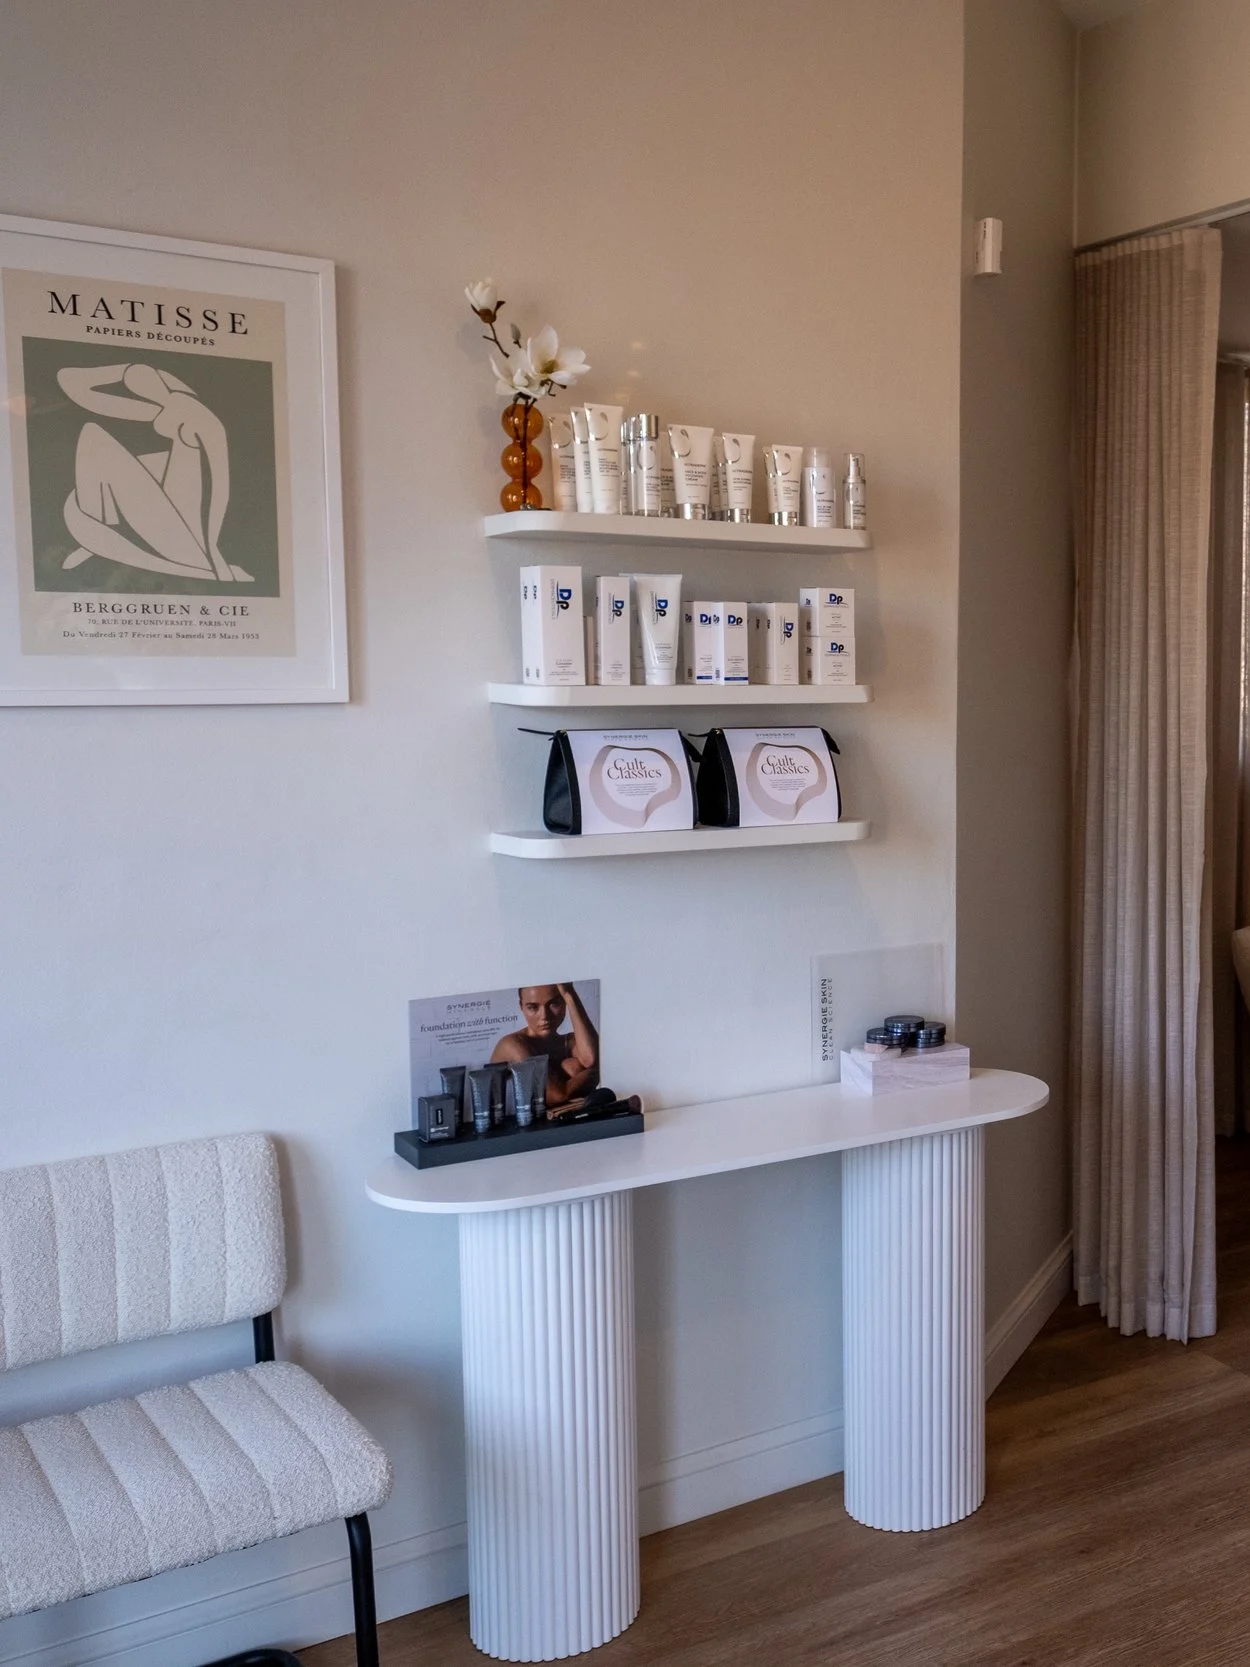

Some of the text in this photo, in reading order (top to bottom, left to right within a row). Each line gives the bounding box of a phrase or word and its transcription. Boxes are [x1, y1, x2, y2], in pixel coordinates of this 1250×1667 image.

[47, 290, 249, 335] MATISSE
[86, 325, 216, 346] PAPIERS DÉCOUPÉS
[556, 588, 572, 611] Dp
[73, 602, 250, 617] BERGGRUEN & CIE
[727, 614, 743, 626] Dp
[79, 630, 116, 638] Vendredi
[613, 757, 646, 771] Cult
[766, 755, 795, 767] Cult
[607, 767, 662, 780] Classics
[761, 763, 810, 775] Classics
[420, 1015, 518, 1033] foundation with function
